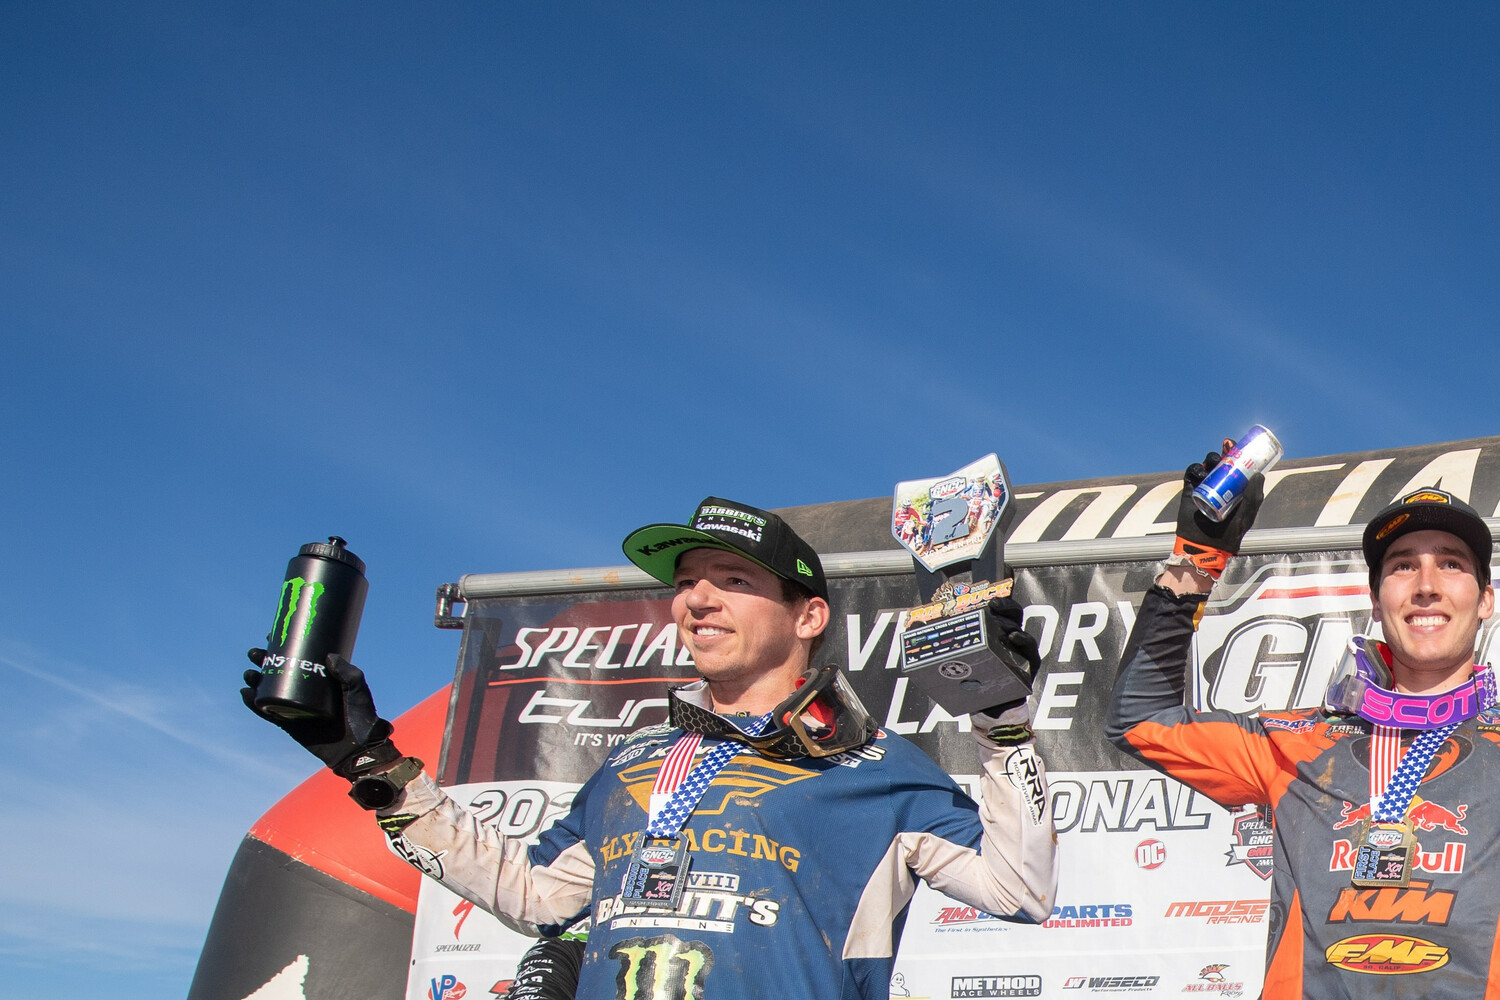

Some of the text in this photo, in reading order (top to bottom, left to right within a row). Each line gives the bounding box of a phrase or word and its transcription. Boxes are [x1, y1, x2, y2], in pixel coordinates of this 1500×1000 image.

[696, 522, 763, 543] Kawasaki
[932, 498, 969, 546] 2
[954, 581, 1014, 612] BUCK
[1136, 842, 1165, 867] DC
[1354, 846, 1371, 880] FIRST
[1366, 850, 1381, 879] PLACE
[597, 892, 781, 927] BAITT'S
[1329, 880, 1455, 923] KTM
[1042, 917, 1133, 928] UNLIMITED
[1205, 915, 1264, 925] RACING
[435, 943, 482, 952] SPECIALIZED
[1327, 939, 1449, 964] FMF
[953, 977, 1041, 990] METHOD
[990, 989, 1040, 997] WHEELS
